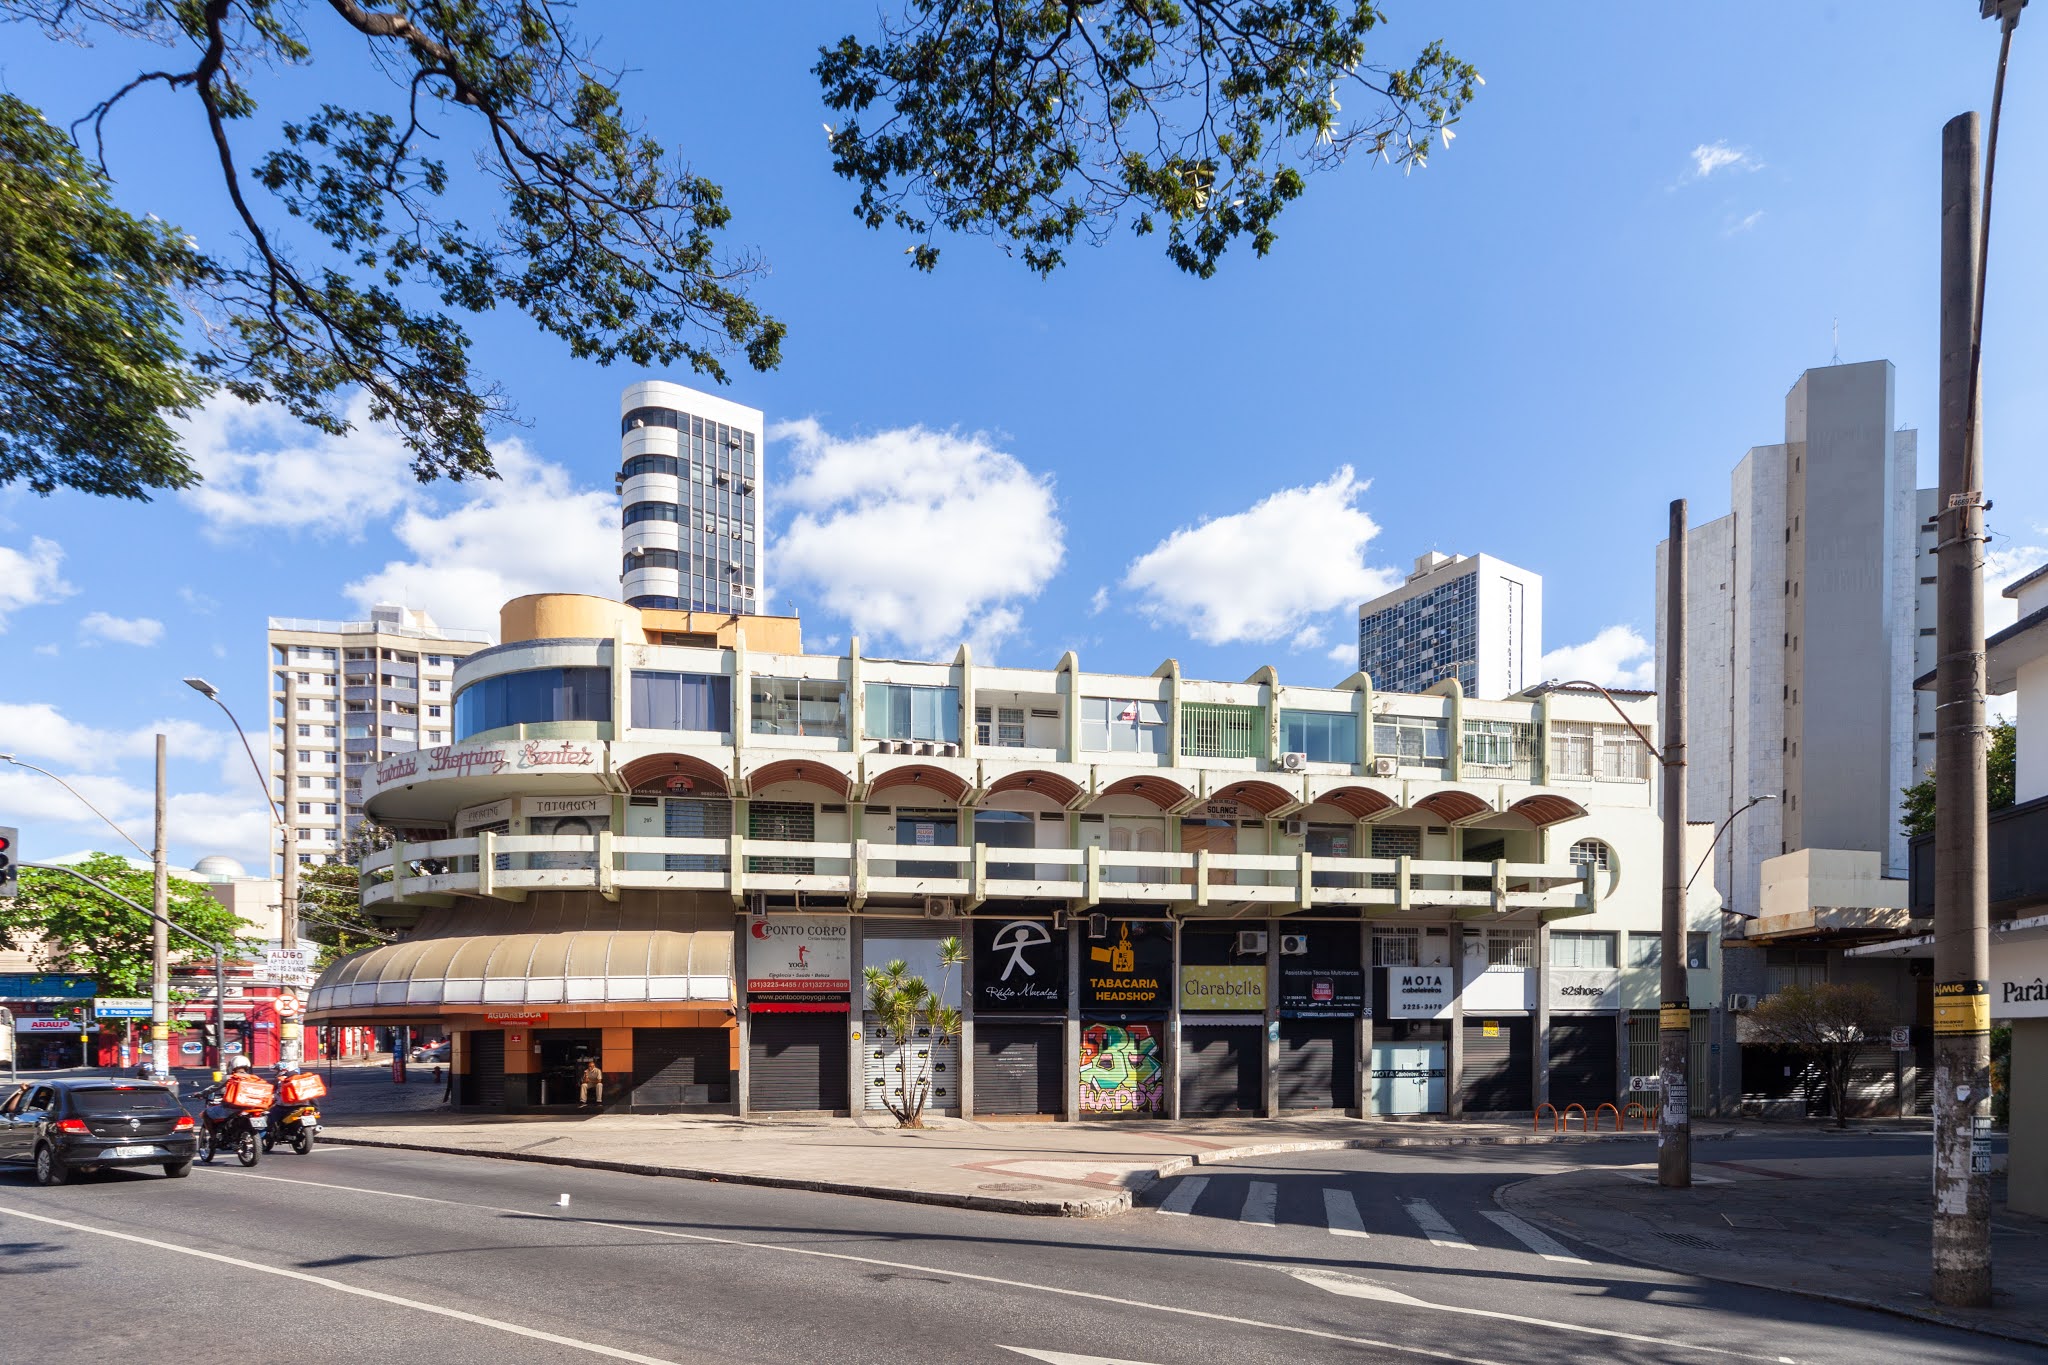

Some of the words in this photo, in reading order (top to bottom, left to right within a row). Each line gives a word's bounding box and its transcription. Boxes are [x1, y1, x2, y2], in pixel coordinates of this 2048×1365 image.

[376, 757, 419, 786] Savassi
[428, 744, 508, 777] Shopping
[522, 740, 594, 768] Center
[536, 800, 596, 812] TATUAGEM
[468, 806, 499, 821] PIERCING
[765, 926, 804, 936] PONTO
[807, 926, 846, 936] CORPO
[1090, 978, 1158, 988] TABACARIA
[1402, 976, 1442, 986] MOTA
[1185, 979, 1261, 996] Clarabella
[1562, 985, 1604, 996] s2shoes
[1096, 992, 1156, 1000] HEADSHOP
[1363, 1008, 1372, 1016] 35
[1080, 1084, 1164, 1112] HAPPY
